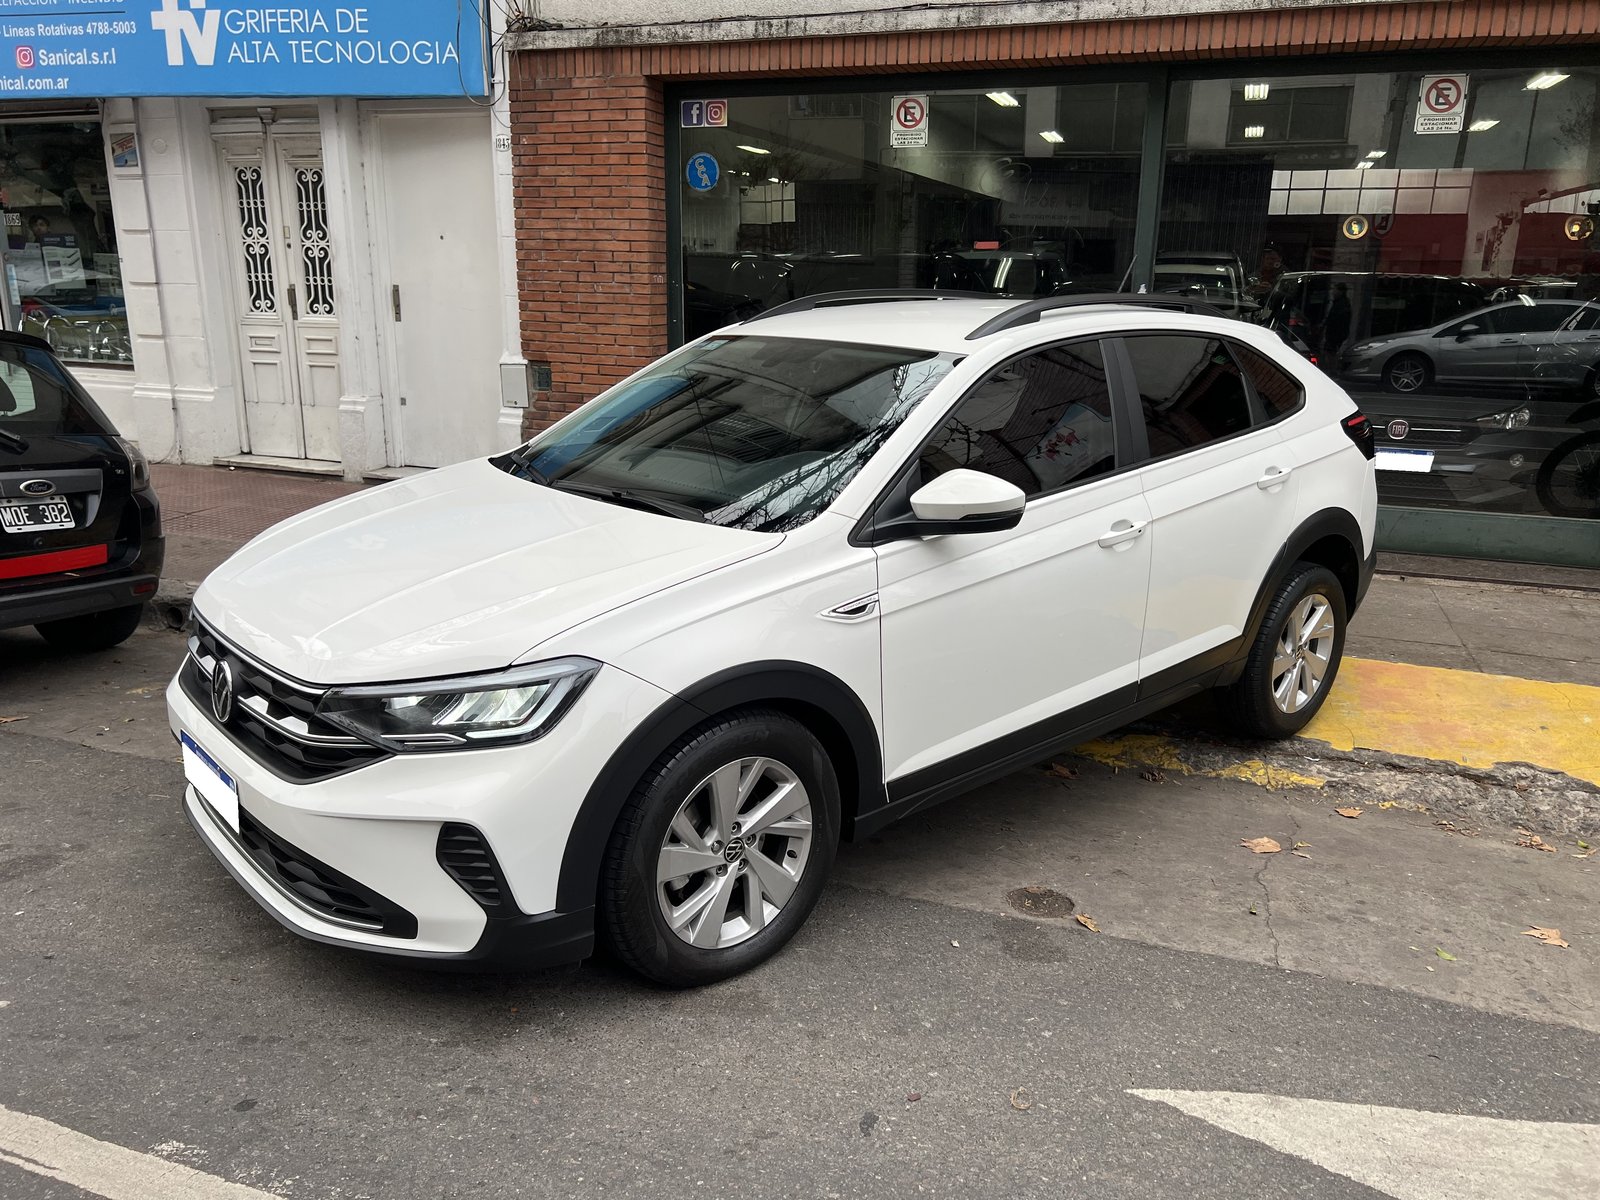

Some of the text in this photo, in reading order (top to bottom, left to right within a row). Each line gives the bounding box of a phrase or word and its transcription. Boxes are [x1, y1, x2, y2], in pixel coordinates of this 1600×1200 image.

[3, 21, 137, 37] Lineas Rotativas 4788-5003
[224, 8, 369, 34] GRIFERIA DE
[39, 48, 117, 66] Sanical.s.r.l
[228, 40, 460, 64] ALTA TECNOLOGIA
[1392, 425, 1406, 435] FIAT
[29, 483, 48, 492] Ford
[39, 504, 70, 522] 382
